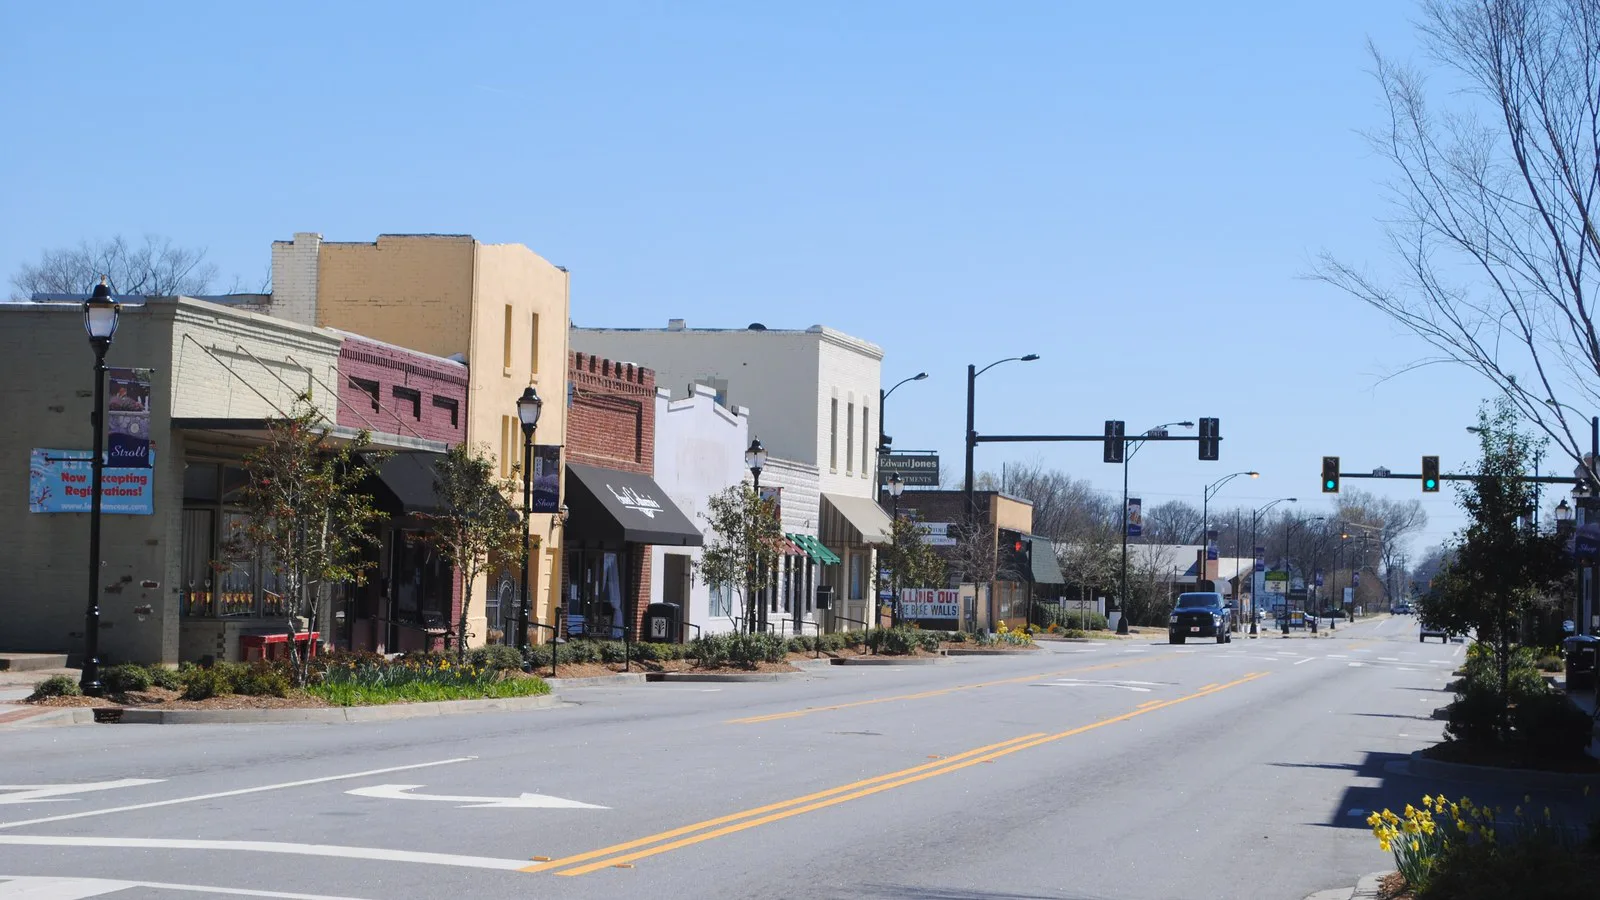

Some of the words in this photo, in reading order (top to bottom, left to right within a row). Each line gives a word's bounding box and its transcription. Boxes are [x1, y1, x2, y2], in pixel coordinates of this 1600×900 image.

[111, 445, 147, 457] Stroll
[61, 472, 86, 482] Now
[100, 473, 147, 486] ccepting
[65, 486, 143, 497] Regirations!
[535, 498, 556, 508] Shop
[938, 591, 958, 604] OUT
